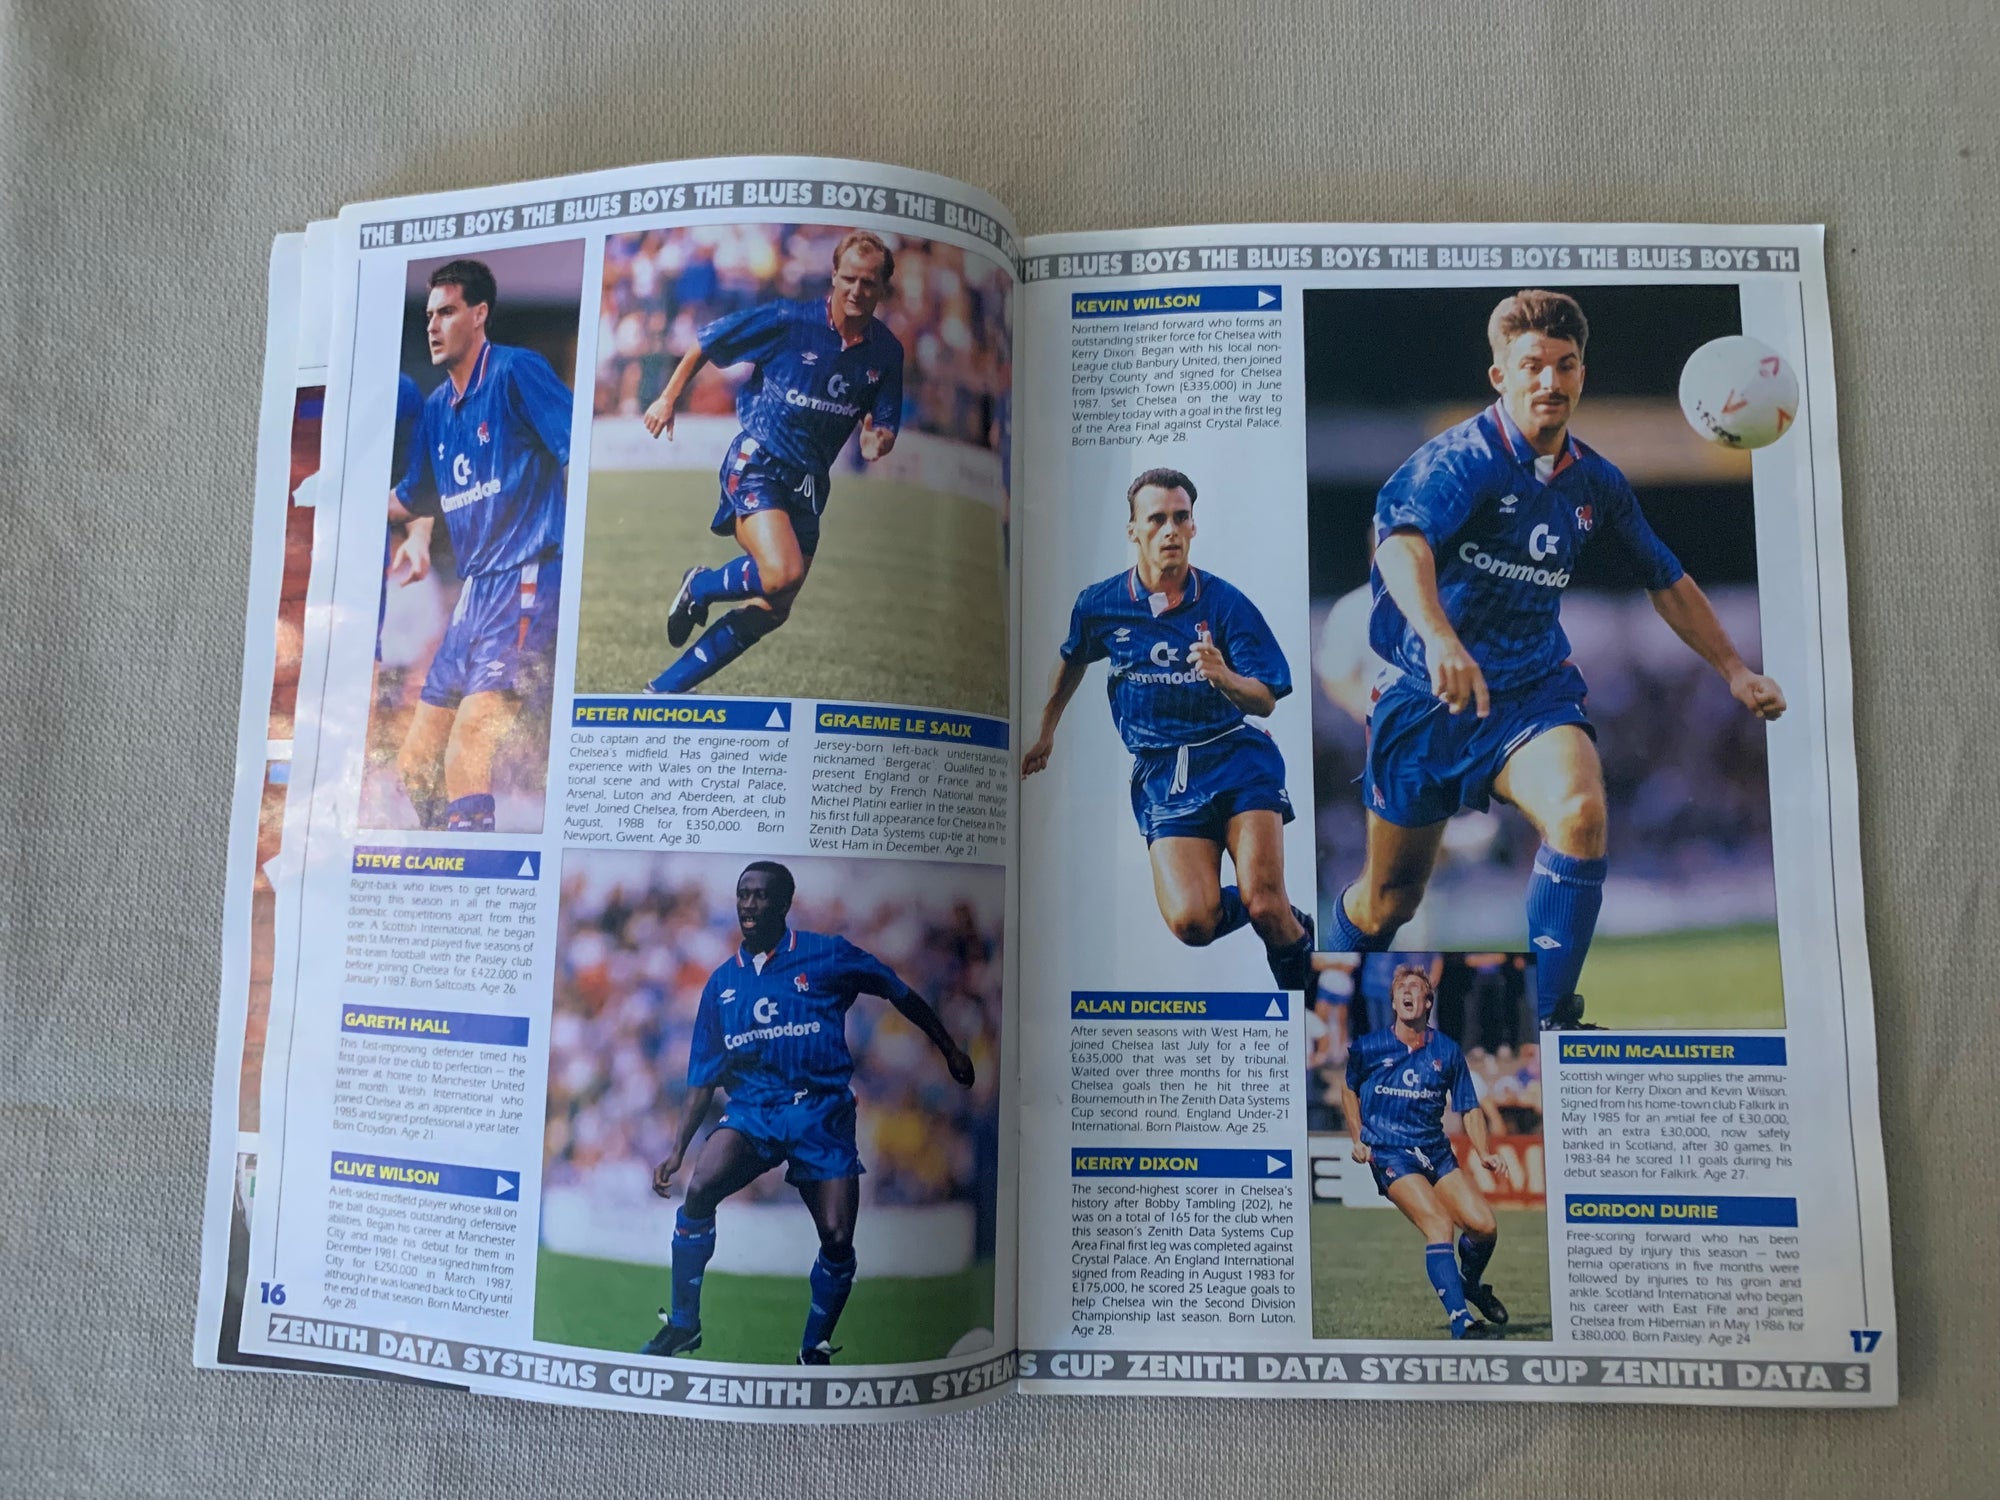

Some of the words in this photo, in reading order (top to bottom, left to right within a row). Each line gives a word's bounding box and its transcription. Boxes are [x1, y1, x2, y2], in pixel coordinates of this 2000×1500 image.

[362, 225, 394, 247] THE
[402, 220, 456, 243] BLUES
[464, 211, 514, 234] BOYS
[522, 206, 555, 227] THE
[563, 195, 621, 222] BLUES
[630, 187, 685, 213] BOYS
[695, 184, 734, 206] THE
[743, 182, 812, 205] BLUES
[822, 184, 886, 211] BOYS
[895, 193, 936, 220] THE
[944, 203, 997, 243] BLUES
[1058, 254, 1122, 277] BLUES
[1132, 250, 1190, 274] BOYS
[1199, 248, 1238, 270] THE
[1247, 248, 1312, 268] BLUES
[1322, 247, 1381, 268] BOYS
[1389, 248, 1428, 268] THE
[1436, 248, 1502, 268] BLUES
[1512, 247, 1570, 268] BOYS
[1578, 248, 1618, 268] THE
[1627, 248, 1692, 268] BLUES
[1701, 248, 1760, 269] BOYS
[1766, 250, 1794, 270] TH
[1076, 298, 1128, 312] KEVIN
[1133, 295, 1200, 310] WILSON
[1071, 323, 1119, 334] Northern
[1123, 321, 1159, 332] Ireland
[1161, 318, 1204, 330] forward
[1207, 318, 1232, 328] who
[1235, 317, 1264, 327] forms
[576, 708, 628, 720] PETER
[633, 708, 726, 722] NICHOLAS
[819, 713, 900, 730] GRAEME
[905, 719, 926, 733] LE
[930, 720, 972, 738] SAUX
[570, 734, 594, 743] Club
[600, 734, 638, 746] captain
[644, 735, 666, 745] and
[672, 736, 691, 745] the
[697, 737, 770, 749] engine-room
[776, 738, 790, 748] of
[809, 839, 838, 849] West
[841, 840, 869, 850] Ham
[872, 840, 882, 850] in
[886, 840, 940, 854] December.
[944, 844, 964, 858] Age
[356, 854, 401, 868] STEVE
[405, 856, 464, 871] CLARKE
[345, 946, 387, 957] first-team
[390, 948, 426, 959] football
[429, 950, 451, 961] with
[455, 952, 471, 962] the
[474, 953, 508, 966] Paisley
[509, 955, 532, 965] club
[1074, 1000, 1126, 1013] ALAN
[1131, 1000, 1207, 1014] DICKENS
[344, 1012, 406, 1030] GARETH
[410, 1018, 450, 1034] HALL
[724, 1021, 820, 1050] Commodore
[1070, 1027, 1098, 1036] After
[1136, 1029, 1178, 1037] seasons
[1181, 1028, 1206, 1037] with
[1211, 1028, 1238, 1037] West
[1242, 1028, 1271, 1039] Ham,
[1274, 1028, 1288, 1037] he
[1562, 1044, 1620, 1058] KEVIN
[1625, 1044, 1735, 1059] McALLISTER
[336, 1067, 369, 1078] winner
[372, 1069, 382, 1078] at
[385, 1070, 412, 1081] home
[416, 1072, 427, 1082] to
[430, 1073, 487, 1087] Manchester
[490, 1078, 525, 1091] United
[1559, 1071, 1602, 1081] Scottish
[1604, 1072, 1646, 1083] winger
[1647, 1072, 1674, 1081] who
[1676, 1072, 1722, 1084] supplies
[1725, 1073, 1744, 1082] the
[1071, 1122, 1142, 1131] International.
[1146, 1122, 1172, 1132] Born
[1174, 1122, 1222, 1132] Plaistow.
[1225, 1123, 1248, 1135] Age
[1251, 1124, 1268, 1133] 25.
[1076, 1156, 1134, 1170] KERRY
[1140, 1157, 1198, 1172] DIXON
[334, 1160, 376, 1178] CLIVE
[380, 1166, 440, 1186] WILSON
[1073, 1185, 1091, 1194] The
[1096, 1185, 1180, 1197] second-highest
[1224, 1187, 1235, 1196] in
[1240, 1186, 1293, 1196] Chelsea's
[1568, 1203, 1654, 1218] GORDON
[1660, 1204, 1718, 1219] DURIE
[326, 1228, 346, 1240] City
[350, 1230, 368, 1241] and
[372, 1232, 398, 1245] made
[402, 1236, 416, 1247] his
[420, 1239, 449, 1251] debut
[454, 1243, 468, 1254] for
[473, 1246, 500, 1258] them
[504, 1250, 515, 1261] in
[1566, 1231, 1635, 1244] Free-scoring
[1645, 1233, 1691, 1242] forward
[1700, 1234, 1728, 1243] who
[1738, 1234, 1759, 1244] has
[1768, 1235, 1798, 1244] been
[260, 1282, 286, 1306] 16
[1071, 1297, 1096, 1309] help
[1102, 1298, 1145, 1307] Chelsea
[1151, 1299, 1173, 1308] win
[1179, 1298, 1198, 1308] the
[1204, 1299, 1244, 1308] Second
[1251, 1299, 1296, 1309] Division
[1569, 1302, 1586, 1311] his
[1593, 1304, 1629, 1312] career
[1636, 1303, 1664, 1313] with
[1672, 1304, 1697, 1314] East
[1706, 1305, 1727, 1315] Fife
[1736, 1306, 1759, 1316] and
[1767, 1307, 1804, 1319] joined
[1850, 1330, 1882, 1353] 17
[270, 1316, 368, 1353] ZENITH
[378, 1332, 452, 1368] DATA
[463, 1348, 596, 1390] SYSTEMS
[610, 1368, 674, 1397] CUP
[686, 1376, 812, 1406] ZENITH
[826, 1379, 920, 1406] DATA
[1050, 1354, 1114, 1378] CUP
[1126, 1355, 1245, 1380] ZENITH
[1258, 1356, 1348, 1380] DATA
[1360, 1358, 1510, 1383] SYSTEMS
[1522, 1359, 1588, 1383] CUP
[1600, 1360, 1726, 1388] ZENITH
[1736, 1364, 1832, 1390] DATA
[1845, 1366, 1866, 1390] S
